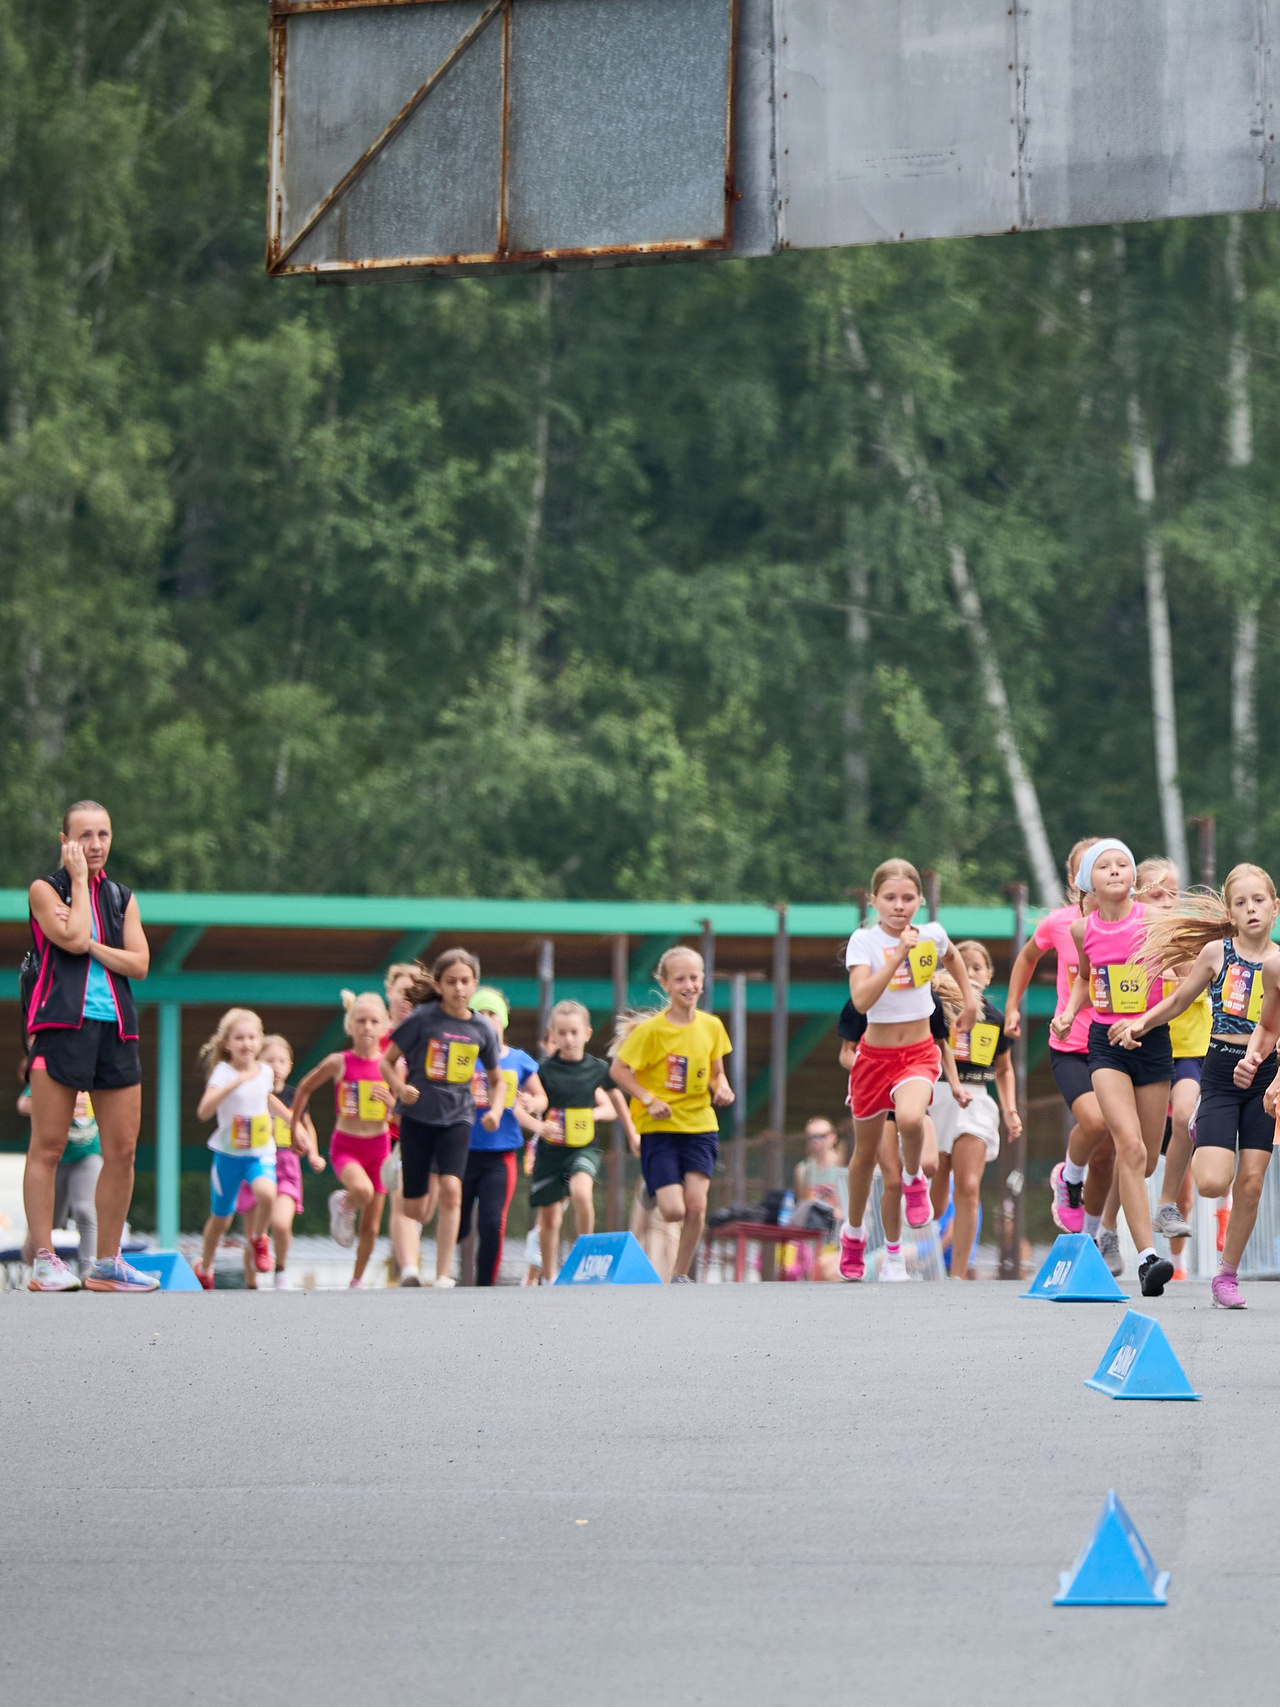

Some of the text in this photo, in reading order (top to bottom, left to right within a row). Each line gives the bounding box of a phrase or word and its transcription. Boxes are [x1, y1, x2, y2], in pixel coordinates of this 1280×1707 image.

[919, 954, 933, 968] 68
[1119, 979, 1140, 993] 65
[979, 1035, 992, 1048] 57
